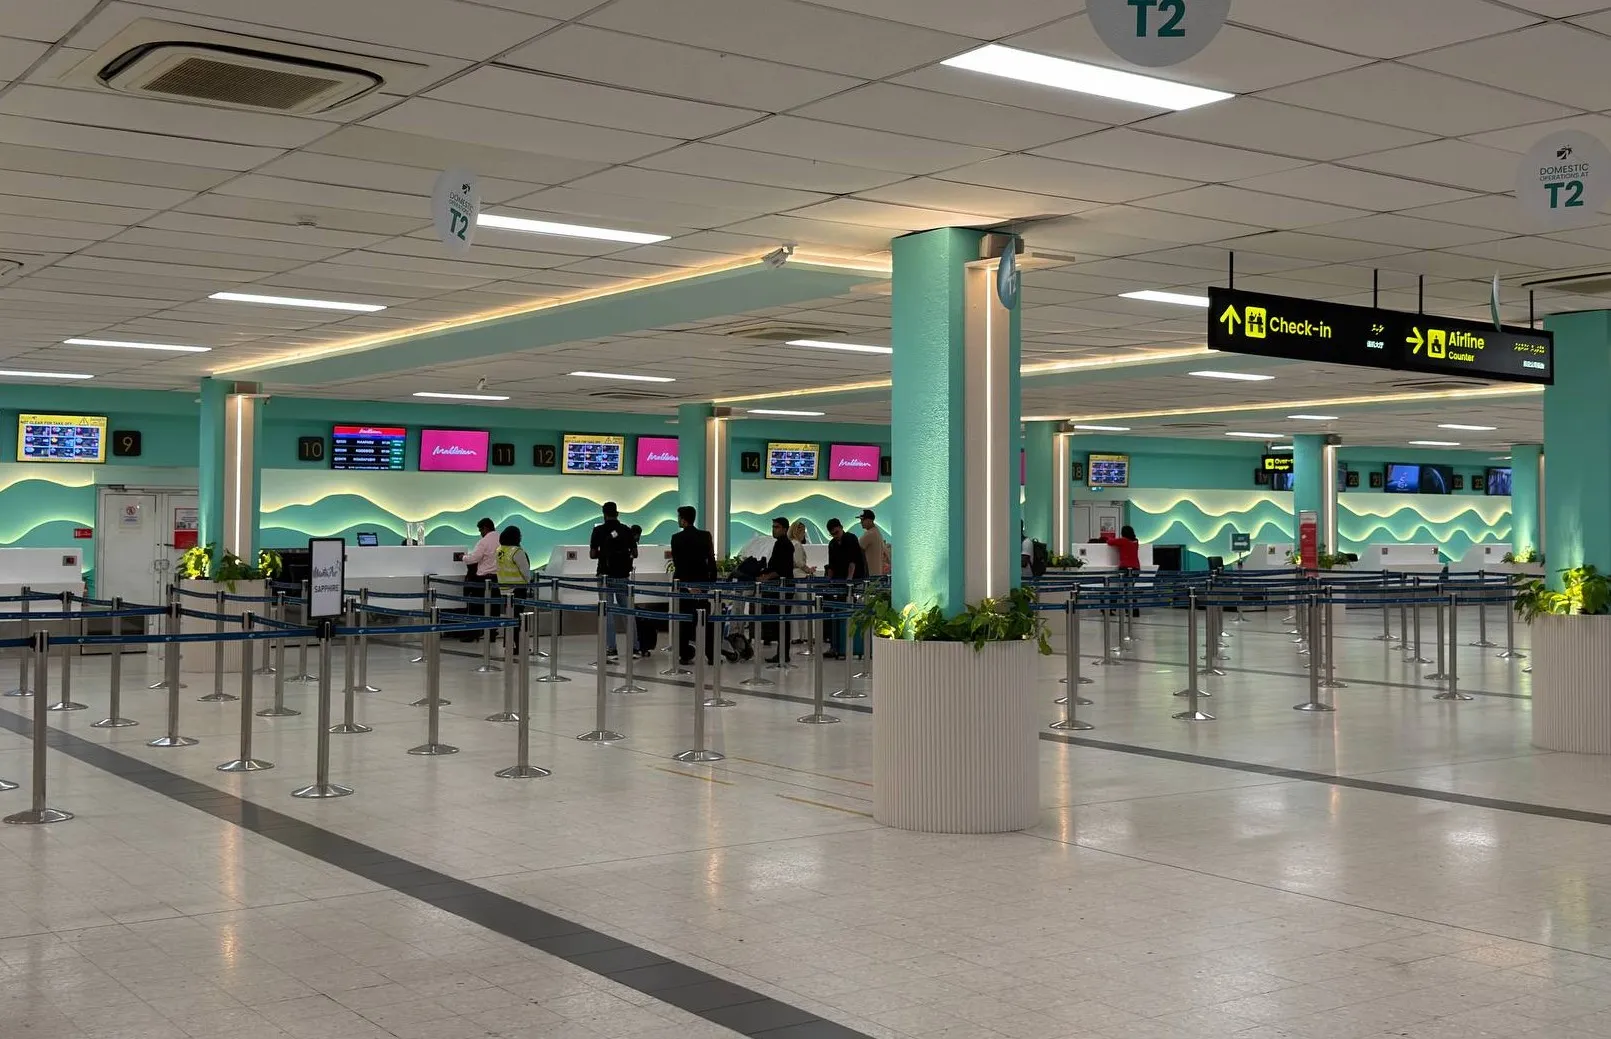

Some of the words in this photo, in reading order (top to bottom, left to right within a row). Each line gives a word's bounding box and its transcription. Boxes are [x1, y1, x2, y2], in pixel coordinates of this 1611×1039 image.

[1127, 0, 1186, 37] T2
[1540, 163, 1589, 175] DOMESTIC
[1540, 172, 1579, 181] OPERATIONS
[1544, 180, 1584, 208] T2
[450, 207, 468, 240] T2
[1269, 317, 1332, 338] Check-in
[1449, 331, 1485, 349] Airline
[1449, 351, 1475, 362] Counter
[121, 436, 133, 452] 9
[303, 442, 322, 457] 10
[497, 448, 511, 463] 11
[538, 449, 554, 464] 12
[745, 456, 759, 470] 14
[313, 584, 340, 593] SAPPHIRE
